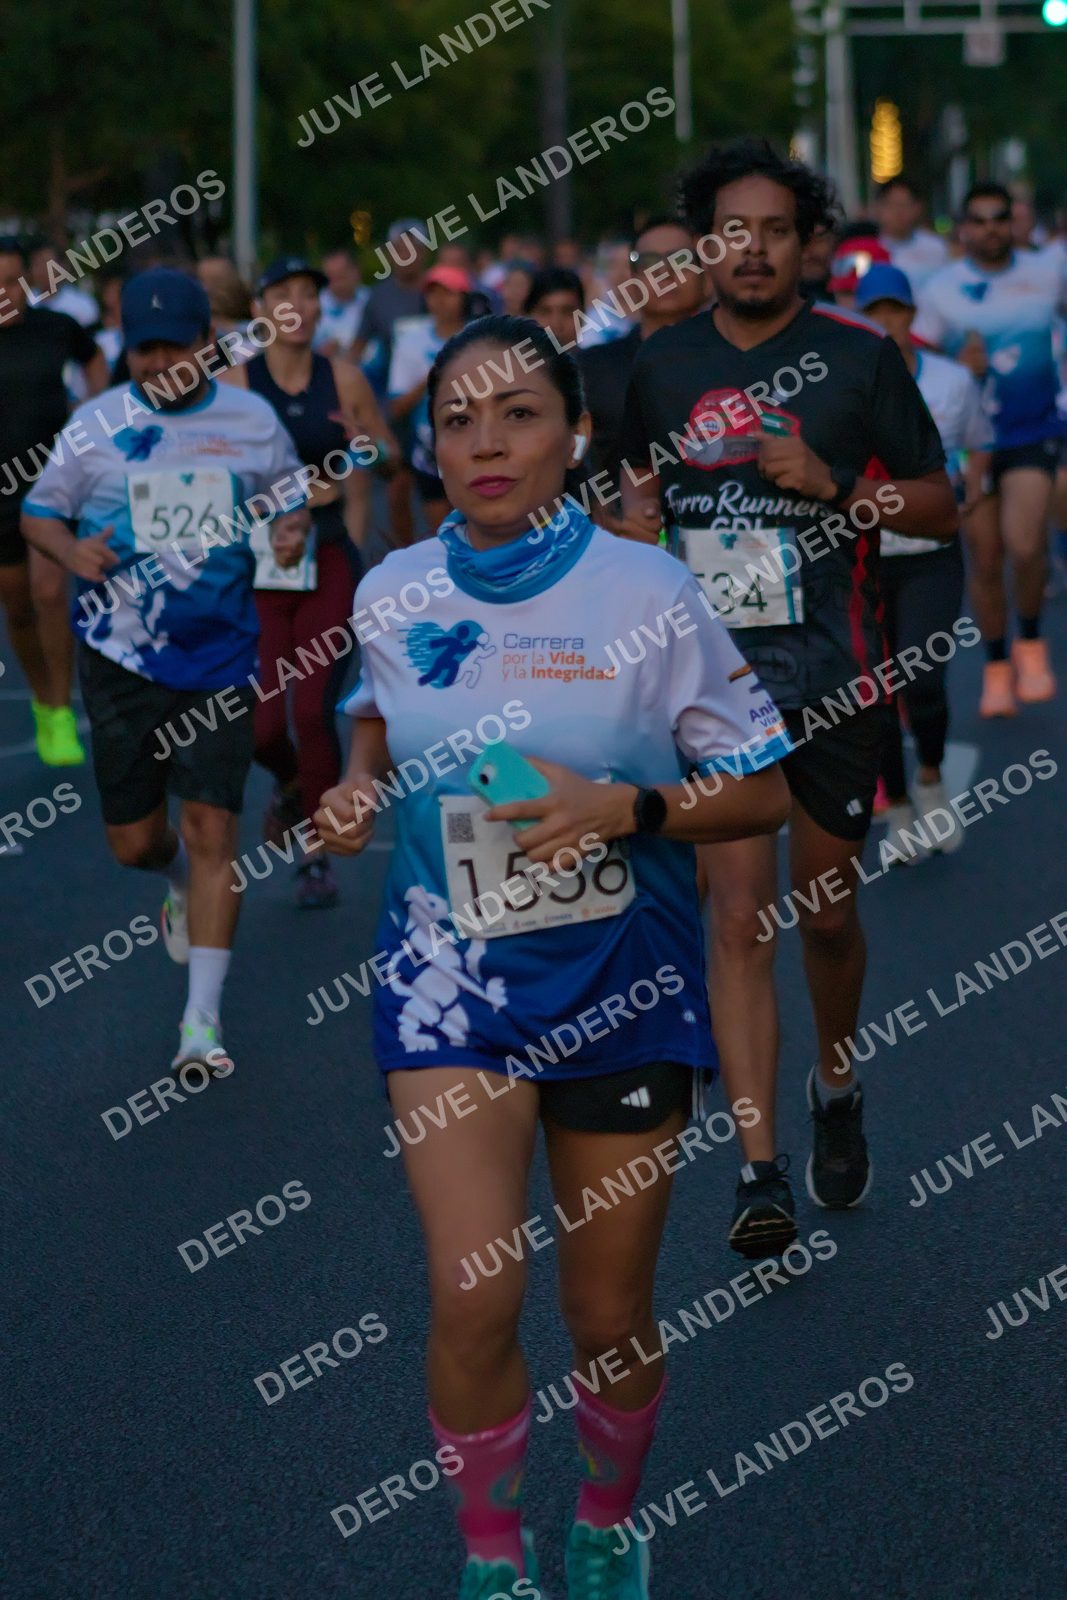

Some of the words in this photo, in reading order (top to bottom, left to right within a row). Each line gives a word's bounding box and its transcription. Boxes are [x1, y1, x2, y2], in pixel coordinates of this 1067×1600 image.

[150, 503, 219, 541] 526
[693, 572, 768, 615] 34
[504, 634, 584, 650] Carrera
[502, 654, 526, 666] por
[532, 652, 544, 665] la
[550, 652, 586, 665] Vida
[502, 668, 510, 681] y
[514, 666, 528, 679] la
[531, 666, 616, 682] Integridad
